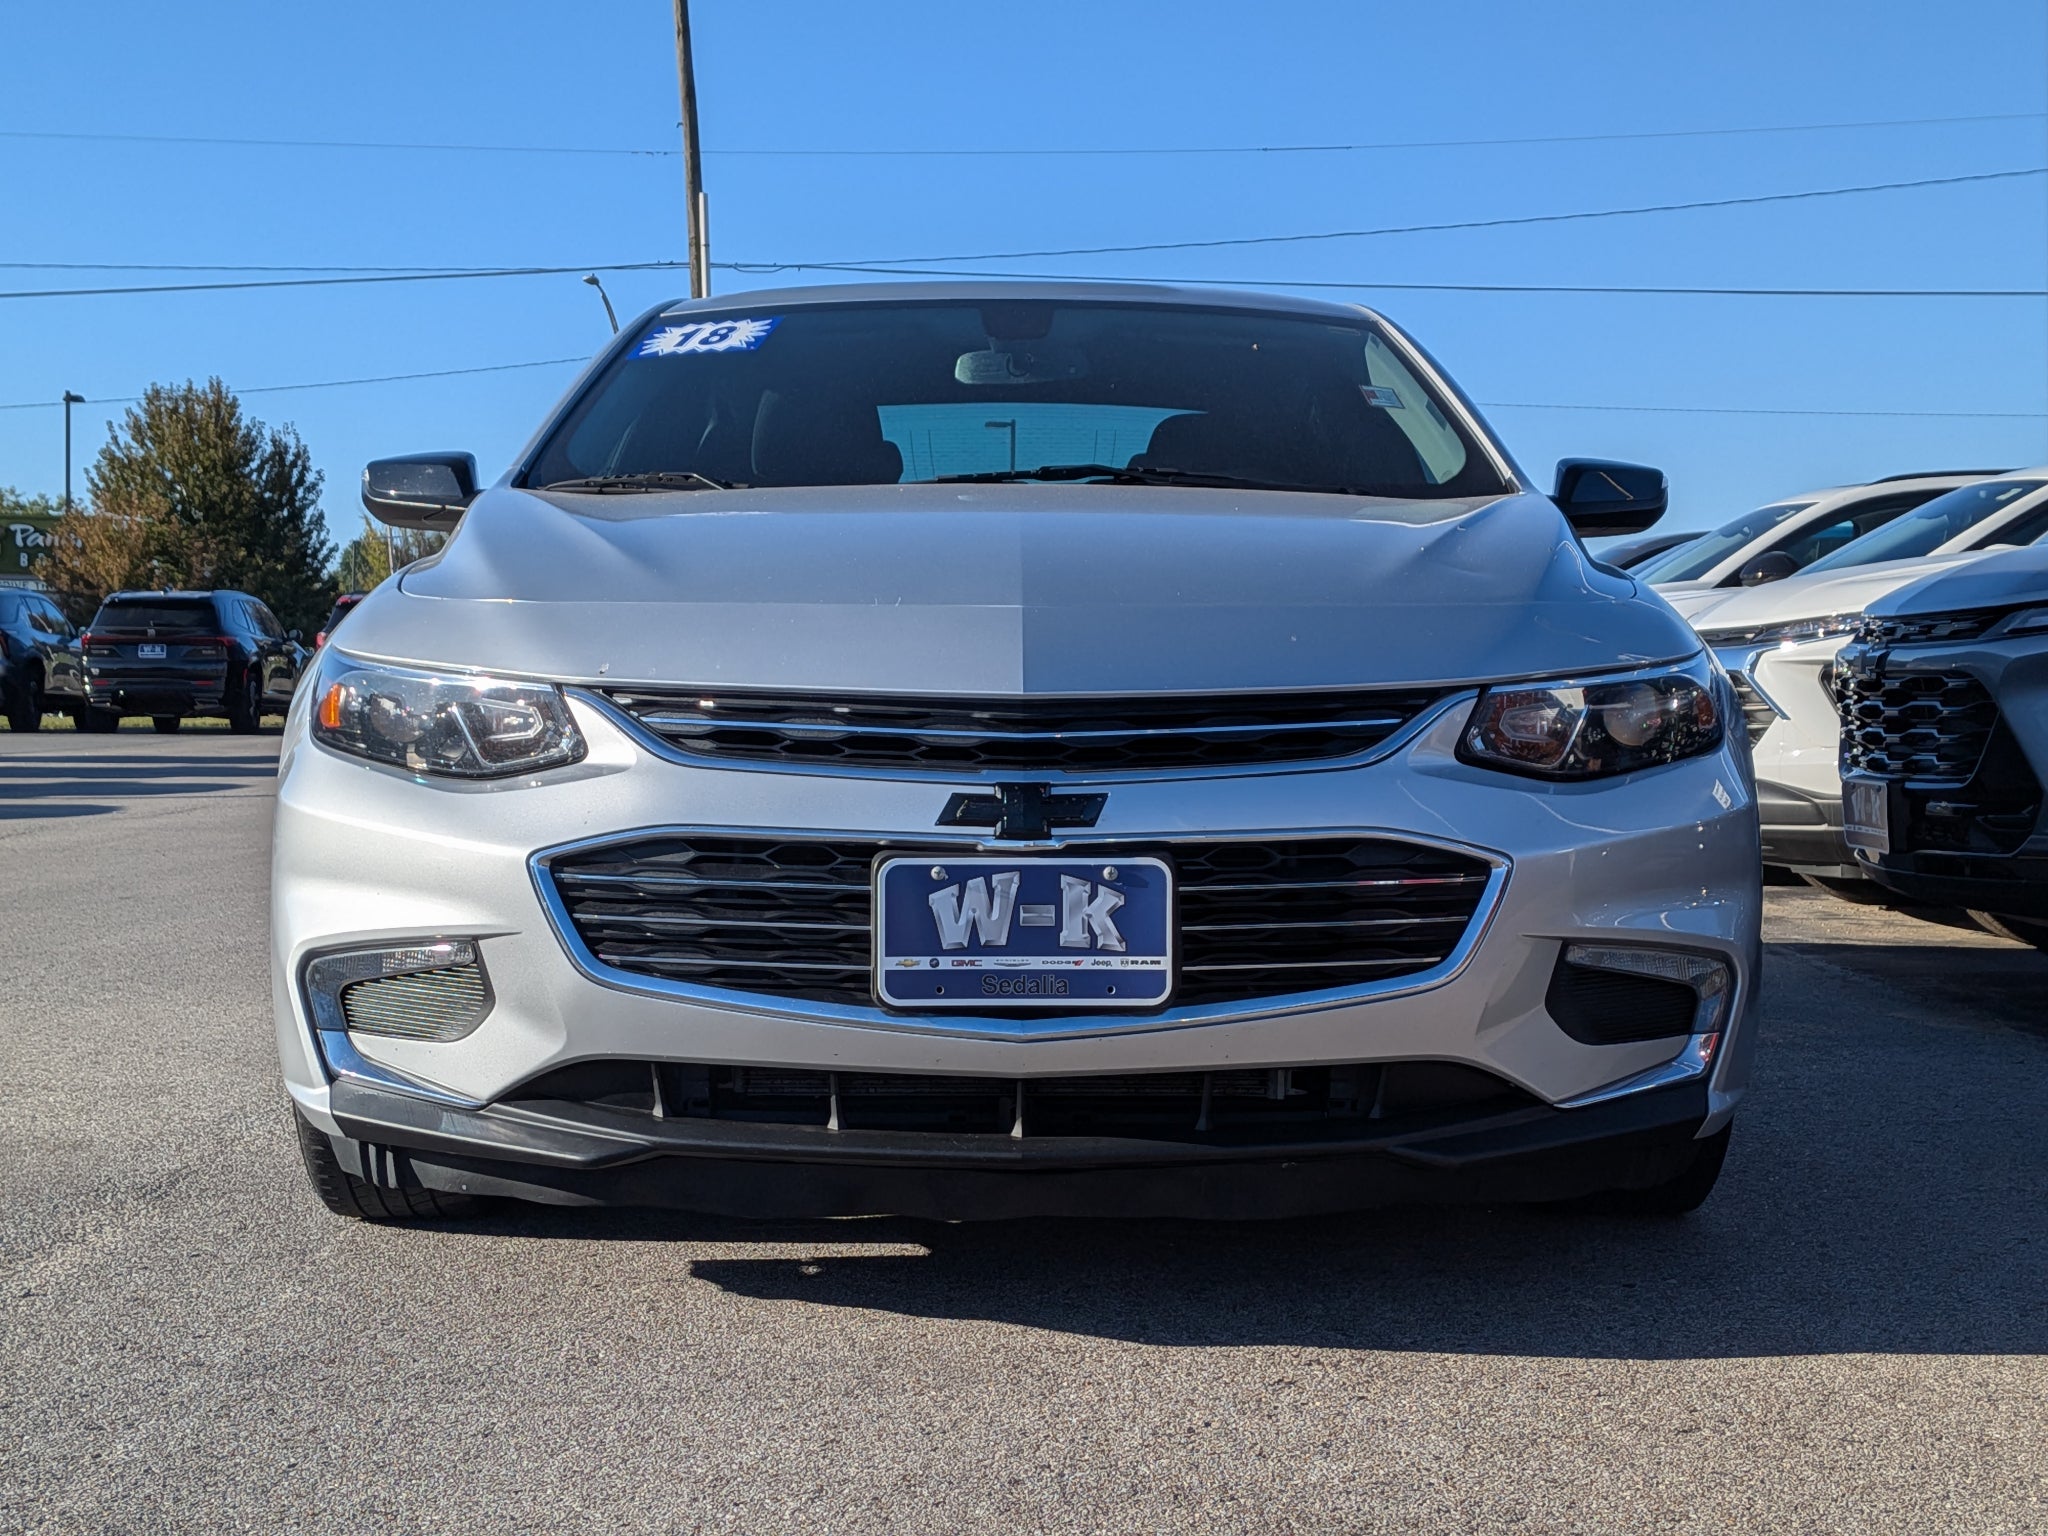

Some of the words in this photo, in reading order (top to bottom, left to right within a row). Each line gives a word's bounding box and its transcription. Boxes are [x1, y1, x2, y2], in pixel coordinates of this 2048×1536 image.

[673, 325, 739, 348] 18
[928, 870, 1126, 952] W-K
[951, 959, 983, 967] GMC
[1091, 959, 1111, 967] Jeep
[982, 974, 1069, 995] Sedalia
